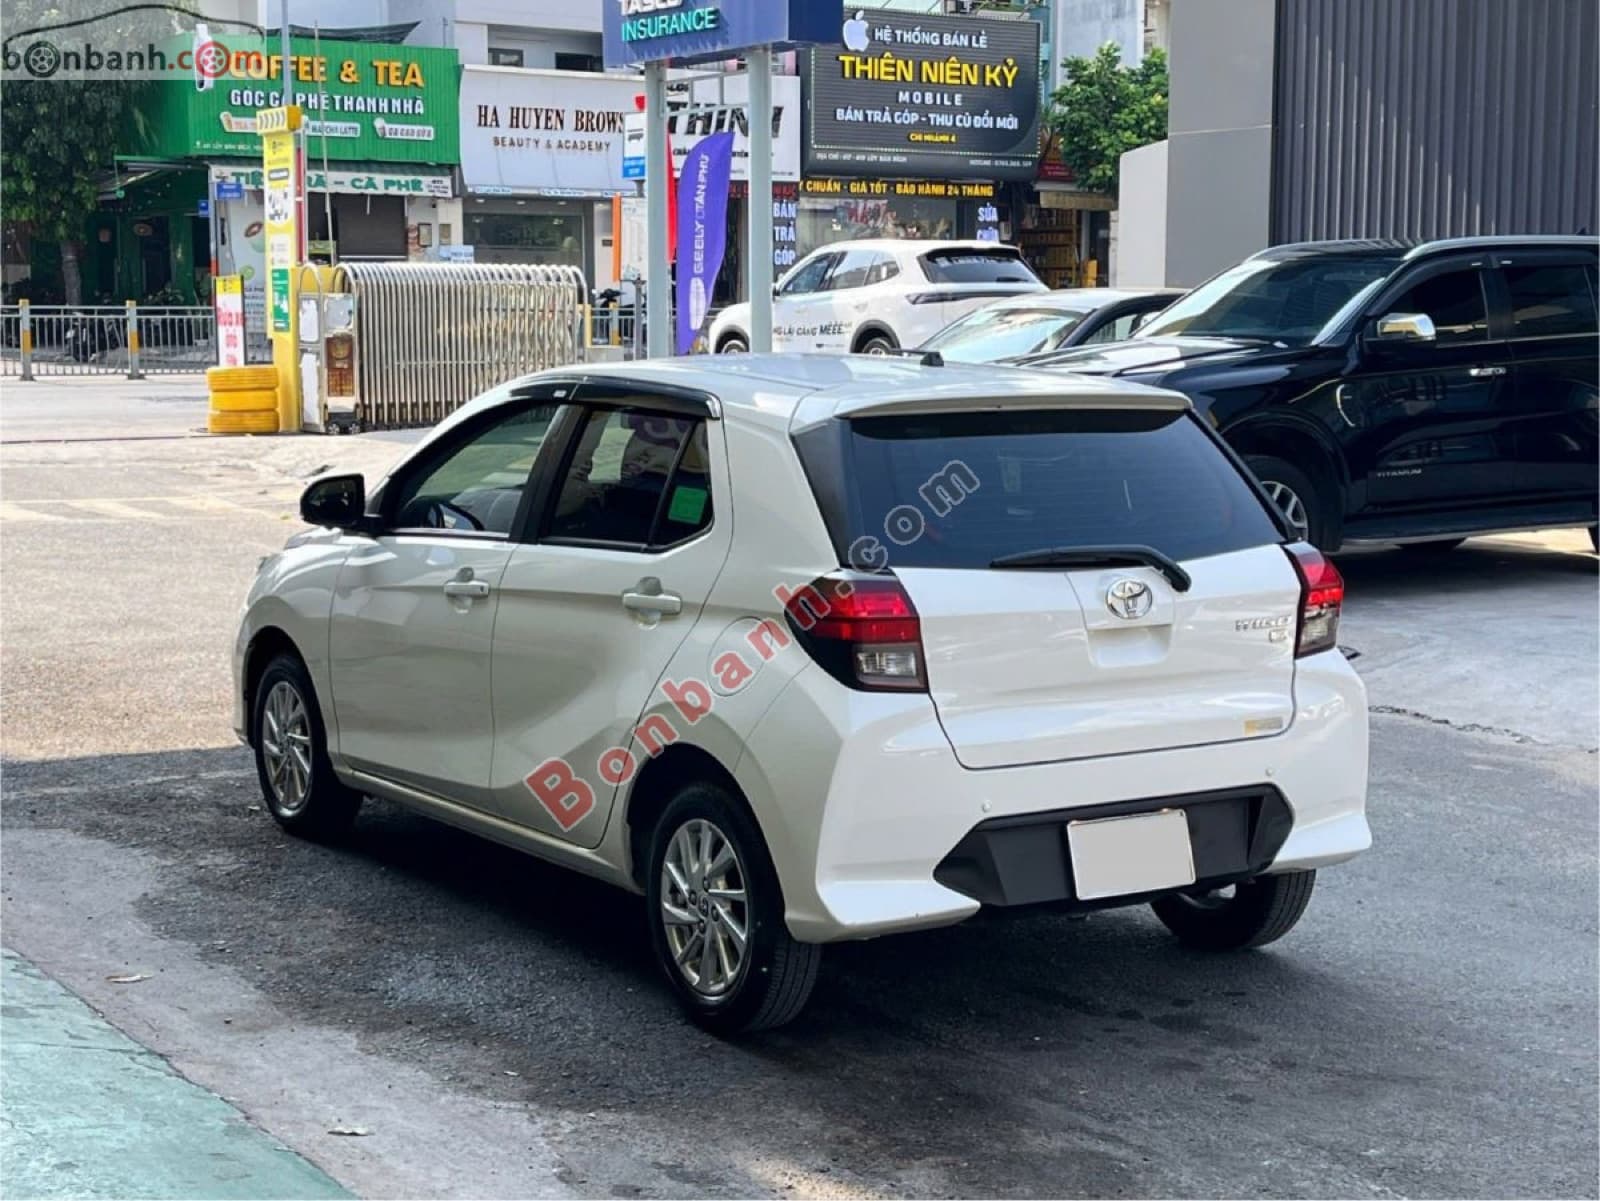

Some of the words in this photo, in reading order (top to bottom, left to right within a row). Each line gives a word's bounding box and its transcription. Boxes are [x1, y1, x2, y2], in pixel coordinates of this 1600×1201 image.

[621, 7, 718, 42] INSURANCE
[875, 25, 892, 42] HỆ
[896, 26, 940, 46] THỐNG
[943, 29, 966, 47] BÁN
[971, 30, 988, 49] LẺ
[229, 53, 327, 82] COFFEE
[339, 60, 360, 84] &
[372, 59, 425, 88] TEA
[838, 52, 914, 83] THIÊN
[921, 57, 979, 86] NIÊN
[984, 58, 1019, 89] KỶ
[332, 95, 389, 113] THANH
[898, 91, 963, 106] MOBILE
[476, 104, 500, 128] HA
[508, 106, 566, 130] HUYEN
[573, 109, 624, 134] BROWS
[836, 108, 864, 122] BÁN
[865, 107, 892, 124] TRẢ
[894, 110, 919, 125] GÓP
[929, 113, 954, 127] THU
[955, 111, 972, 129] CŨ
[973, 109, 994, 129] ĐỔI
[996, 113, 1019, 130] MỚI
[492, 136, 540, 149] BEAUTY
[556, 139, 611, 152] ACADEMY
[350, 175, 378, 191] CÀ
[384, 177, 424, 192] PHÊ
[806, 177, 841, 193] CHUẨN
[869, 179, 888, 194] TỐT
[946, 184, 960, 196] 24
[962, 182, 993, 197] THÁNG
[773, 199, 797, 218] BÁN
[773, 222, 796, 242] TRẢ
[693, 220, 704, 274] GEELY
[773, 247, 797, 266] GÓP
